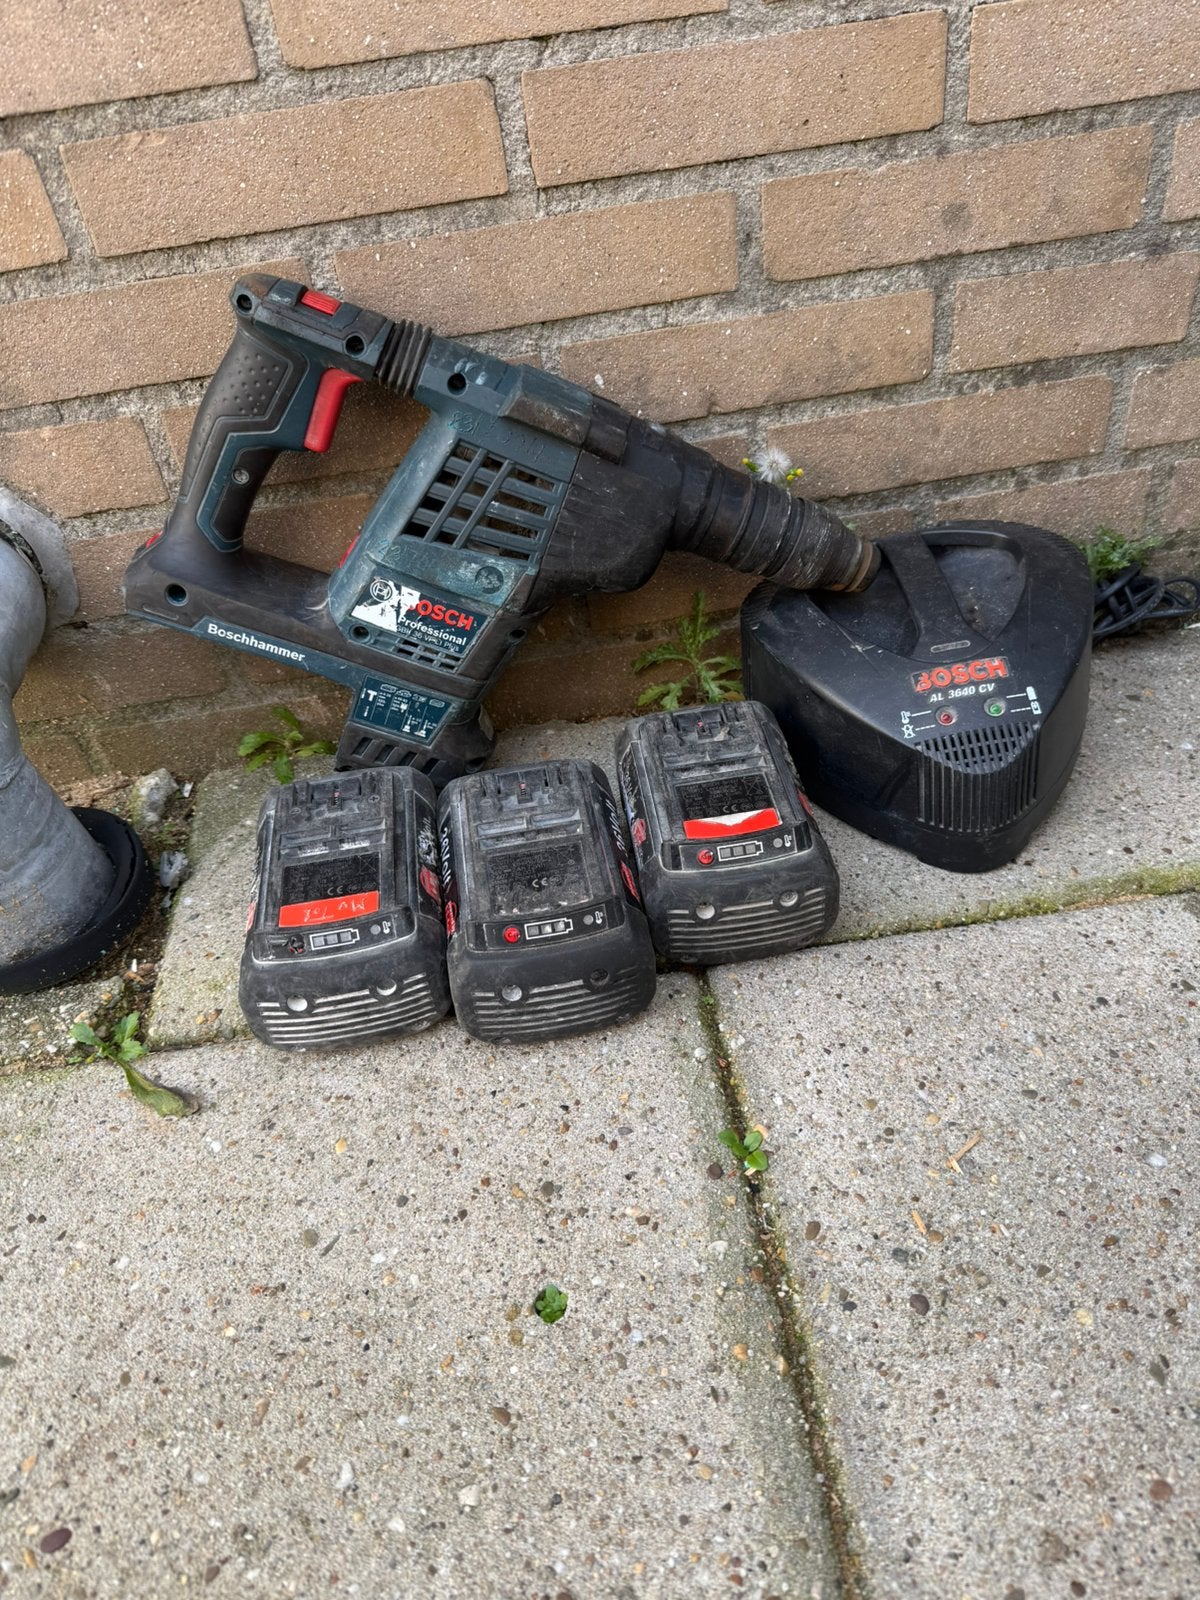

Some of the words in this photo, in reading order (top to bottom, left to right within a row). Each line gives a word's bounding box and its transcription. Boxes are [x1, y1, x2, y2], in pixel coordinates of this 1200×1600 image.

[408, 599, 474, 631] OSCH
[207, 623, 305, 662] Boschhammer
[397, 616, 467, 646] Professional
[929, 692, 945, 703] AL
[948, 687, 976, 699] 3640
[978, 682, 996, 693] CV
